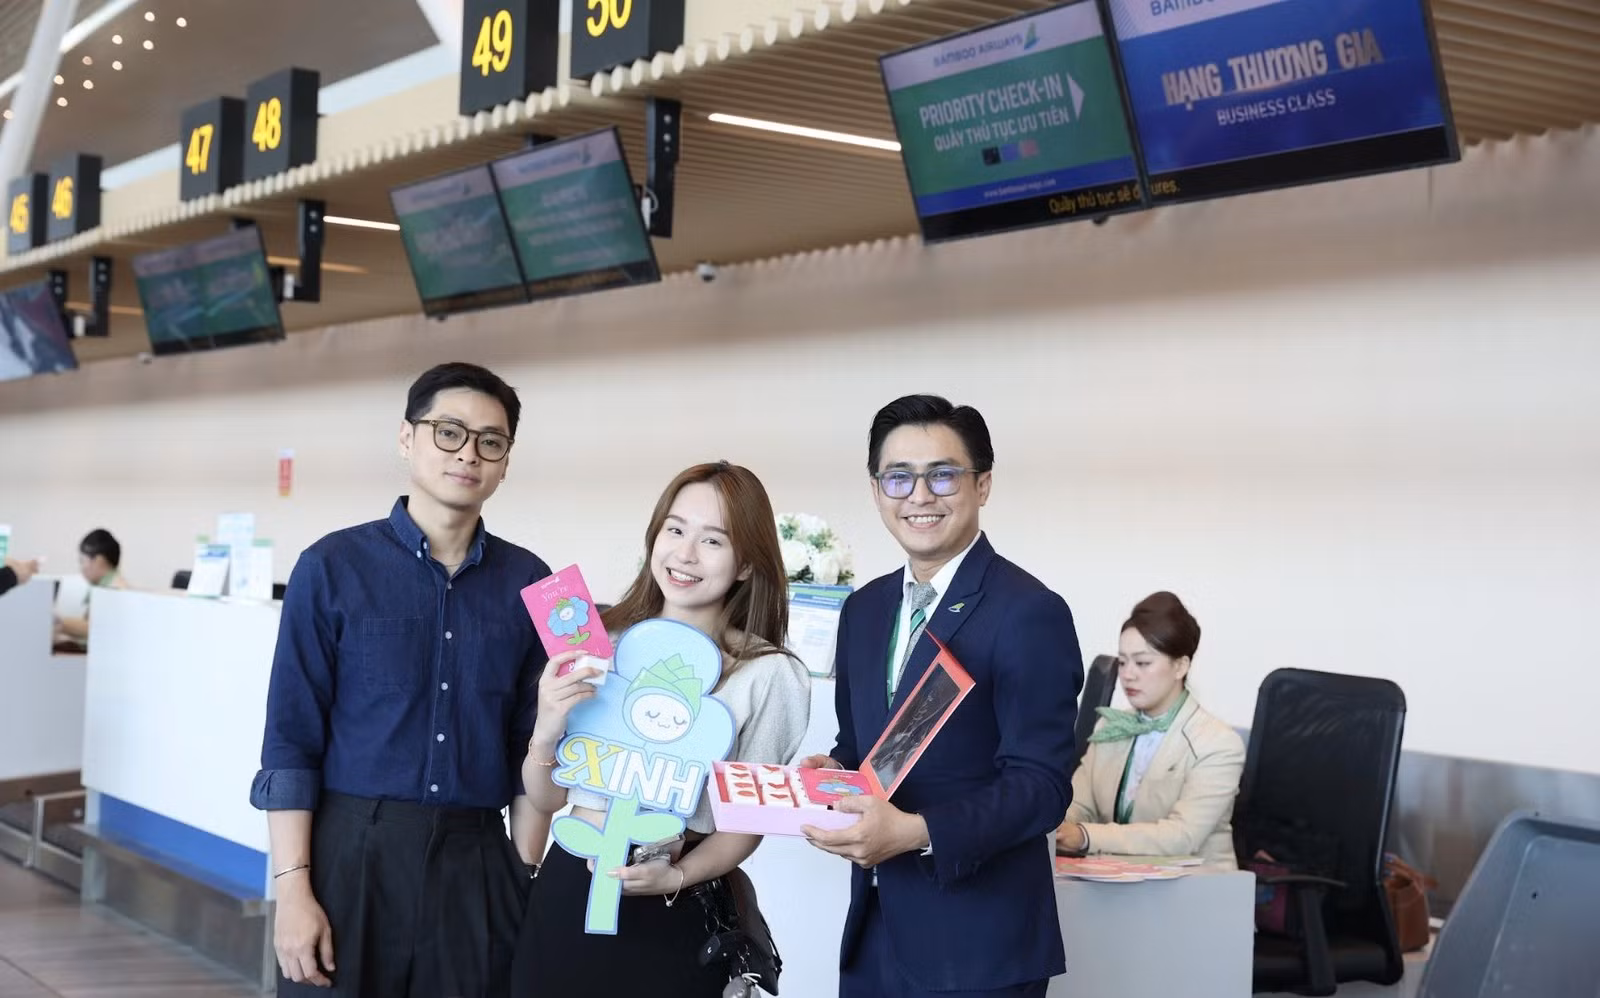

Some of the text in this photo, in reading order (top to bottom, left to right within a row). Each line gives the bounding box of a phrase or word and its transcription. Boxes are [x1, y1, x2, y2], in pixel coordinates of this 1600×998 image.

[1150, 0, 1217, 16] BAM
[472, 9, 512, 76] 49
[933, 32, 1024, 68] BAMBOO AIRWAYS
[1162, 27, 1384, 111] HẠNG THƯƠNG GIA
[252, 97, 281, 152] 48
[919, 73, 1064, 128] PRIORITY CHECK-IN
[1216, 87, 1337, 126] BUSINESS CLASS
[186, 123, 214, 175] 47
[51, 175, 73, 219] 46
[561, 737, 699, 811] XINH
